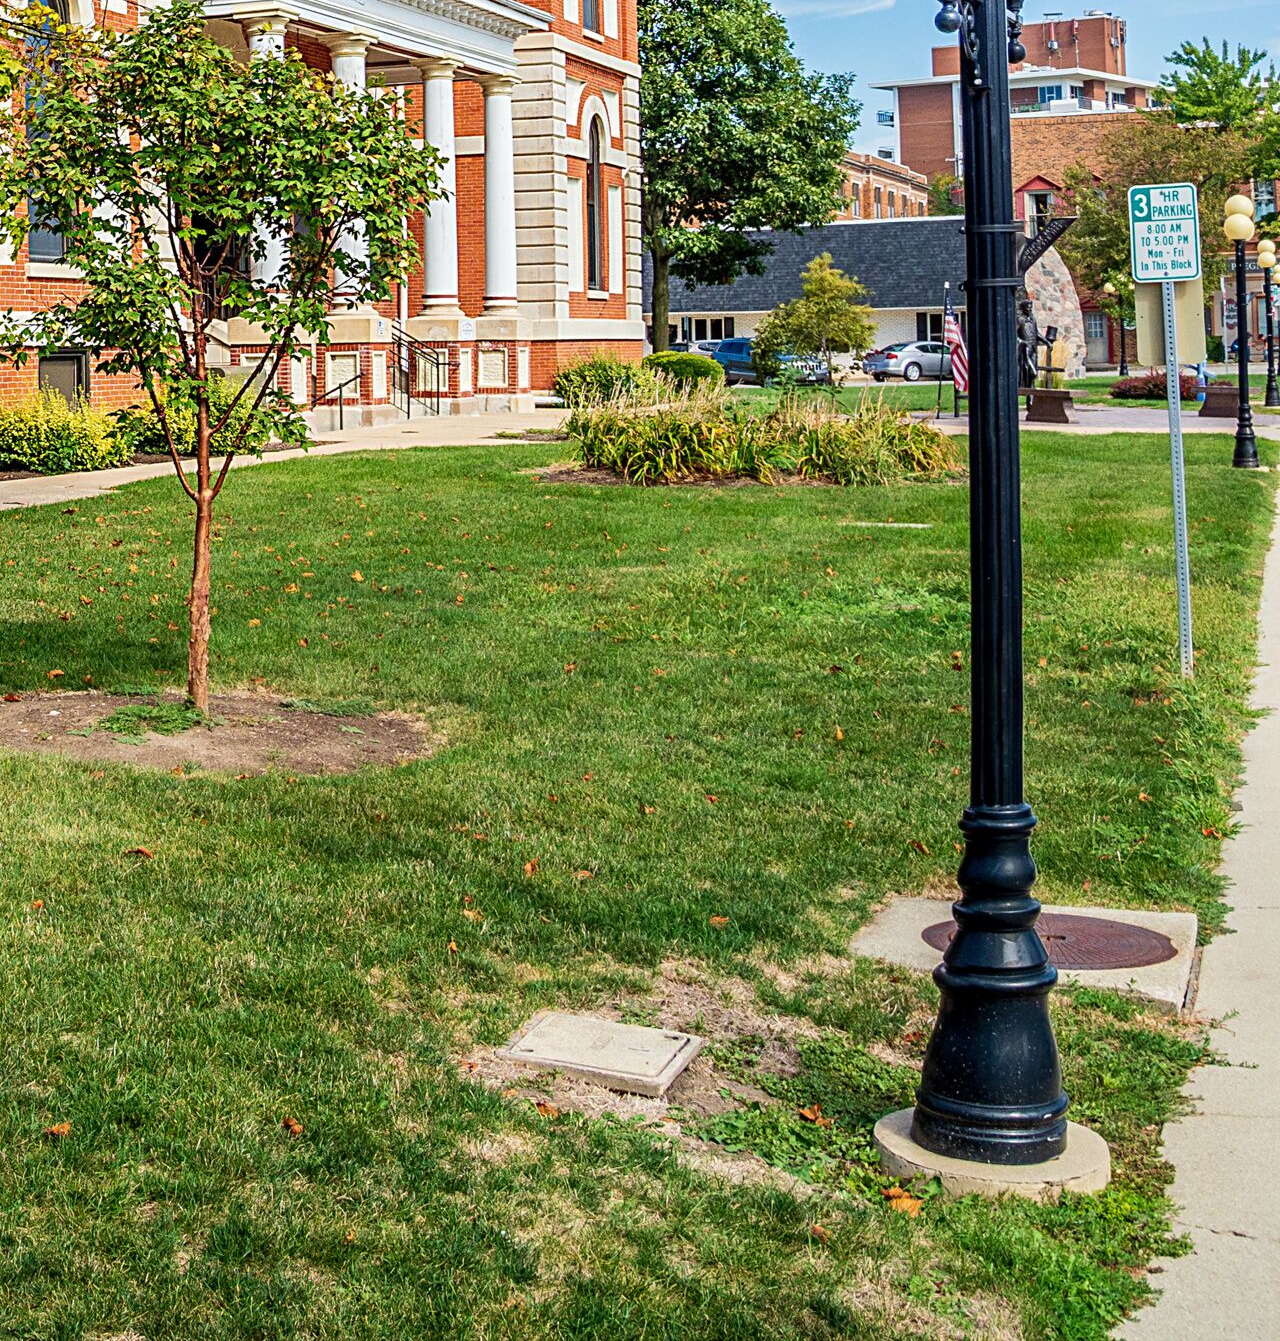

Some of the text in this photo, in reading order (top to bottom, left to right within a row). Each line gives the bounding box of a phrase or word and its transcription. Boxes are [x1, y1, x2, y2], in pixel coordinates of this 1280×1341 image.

[1134, 191, 1179, 217] 3 HR
[1153, 204, 1192, 217] PARKING
[1170, 223, 1181, 232] AM
[1141, 237, 1150, 246] TO
[1178, 235, 1189, 244] PM
[1148, 250, 1163, 258] Mon
[1174, 248, 1184, 257] Fri
[1141, 260, 1192, 271] In This Block
